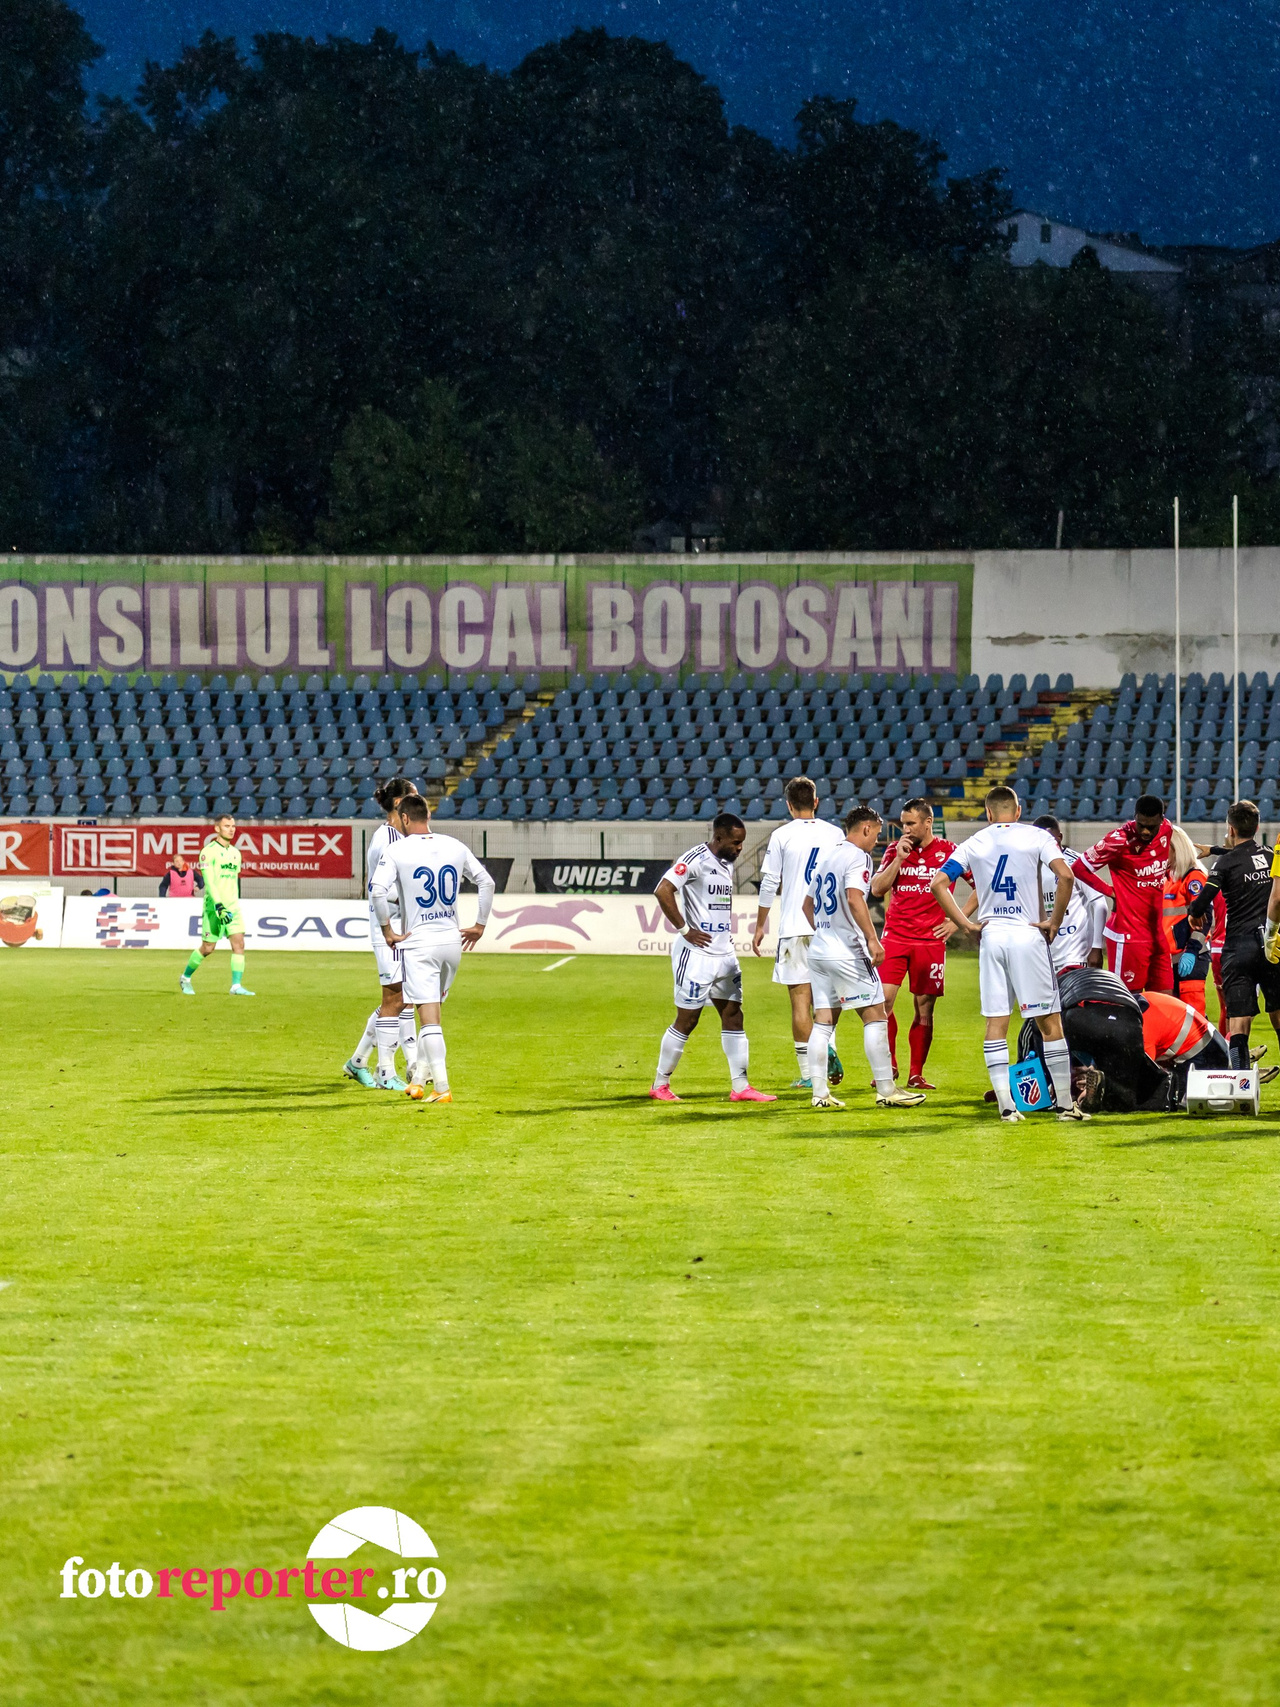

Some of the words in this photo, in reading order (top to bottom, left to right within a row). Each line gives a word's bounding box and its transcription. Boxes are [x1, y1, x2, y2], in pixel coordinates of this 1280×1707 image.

[0, 586, 330, 667] ONSILIUL
[351, 586, 572, 667] LOCAL
[592, 585, 952, 668] BOTOSANI
[260, 862, 320, 871] INDUSTRIALE
[552, 865, 646, 888] UNIBET
[413, 864, 459, 909] 30
[991, 854, 1017, 901] 4
[993, 906, 1022, 916] MIRON
[816, 921, 831, 930] AVID
[929, 962, 945, 980] 23
